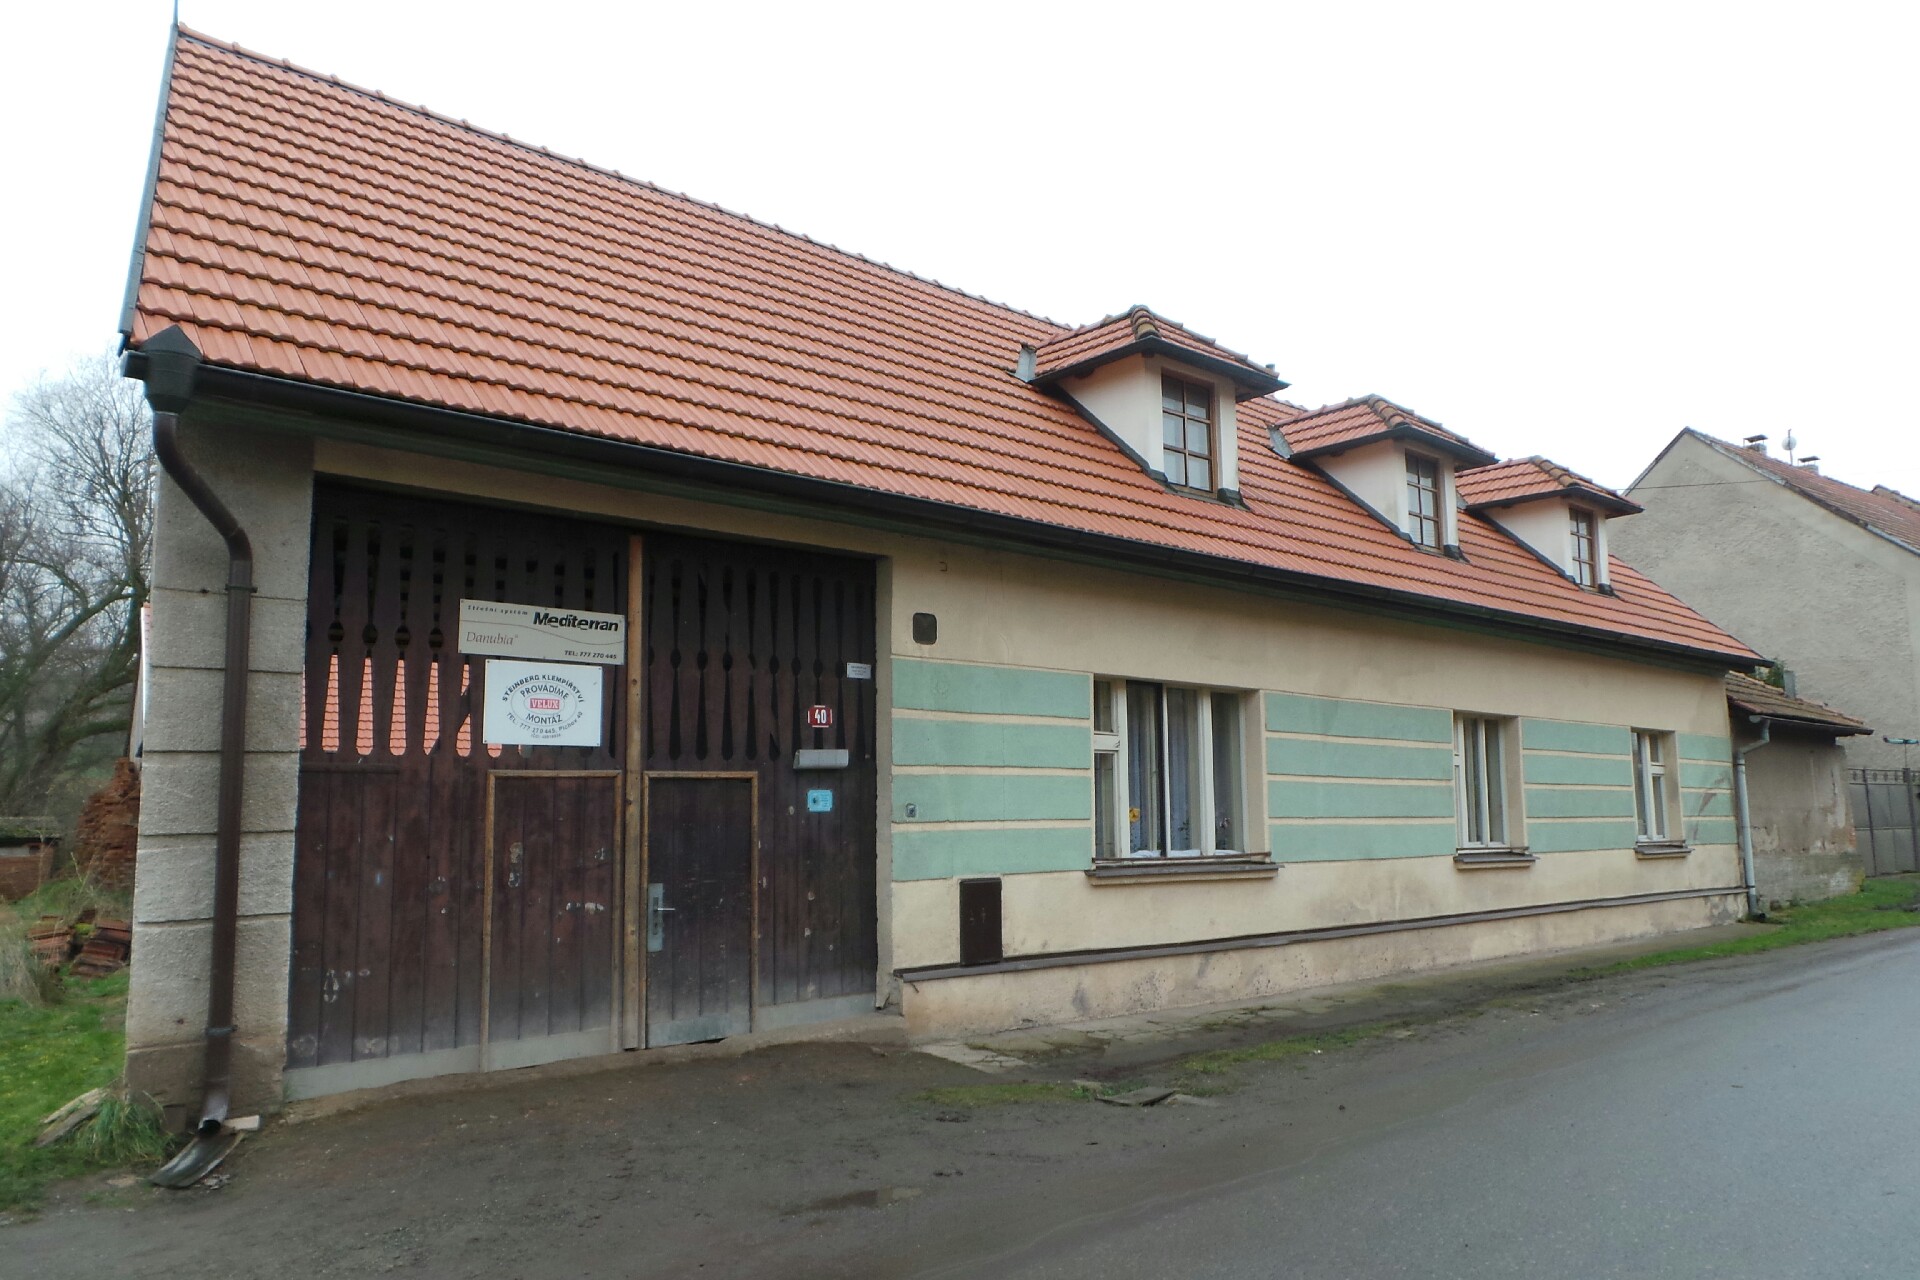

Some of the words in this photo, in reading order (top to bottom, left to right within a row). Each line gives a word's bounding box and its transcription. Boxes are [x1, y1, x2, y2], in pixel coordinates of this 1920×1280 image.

[533, 611, 619, 631] Mediterran
[502, 674, 540, 702] STEINBERG
[531, 699, 559, 709] VELUX
[814, 709, 827, 724] 40
